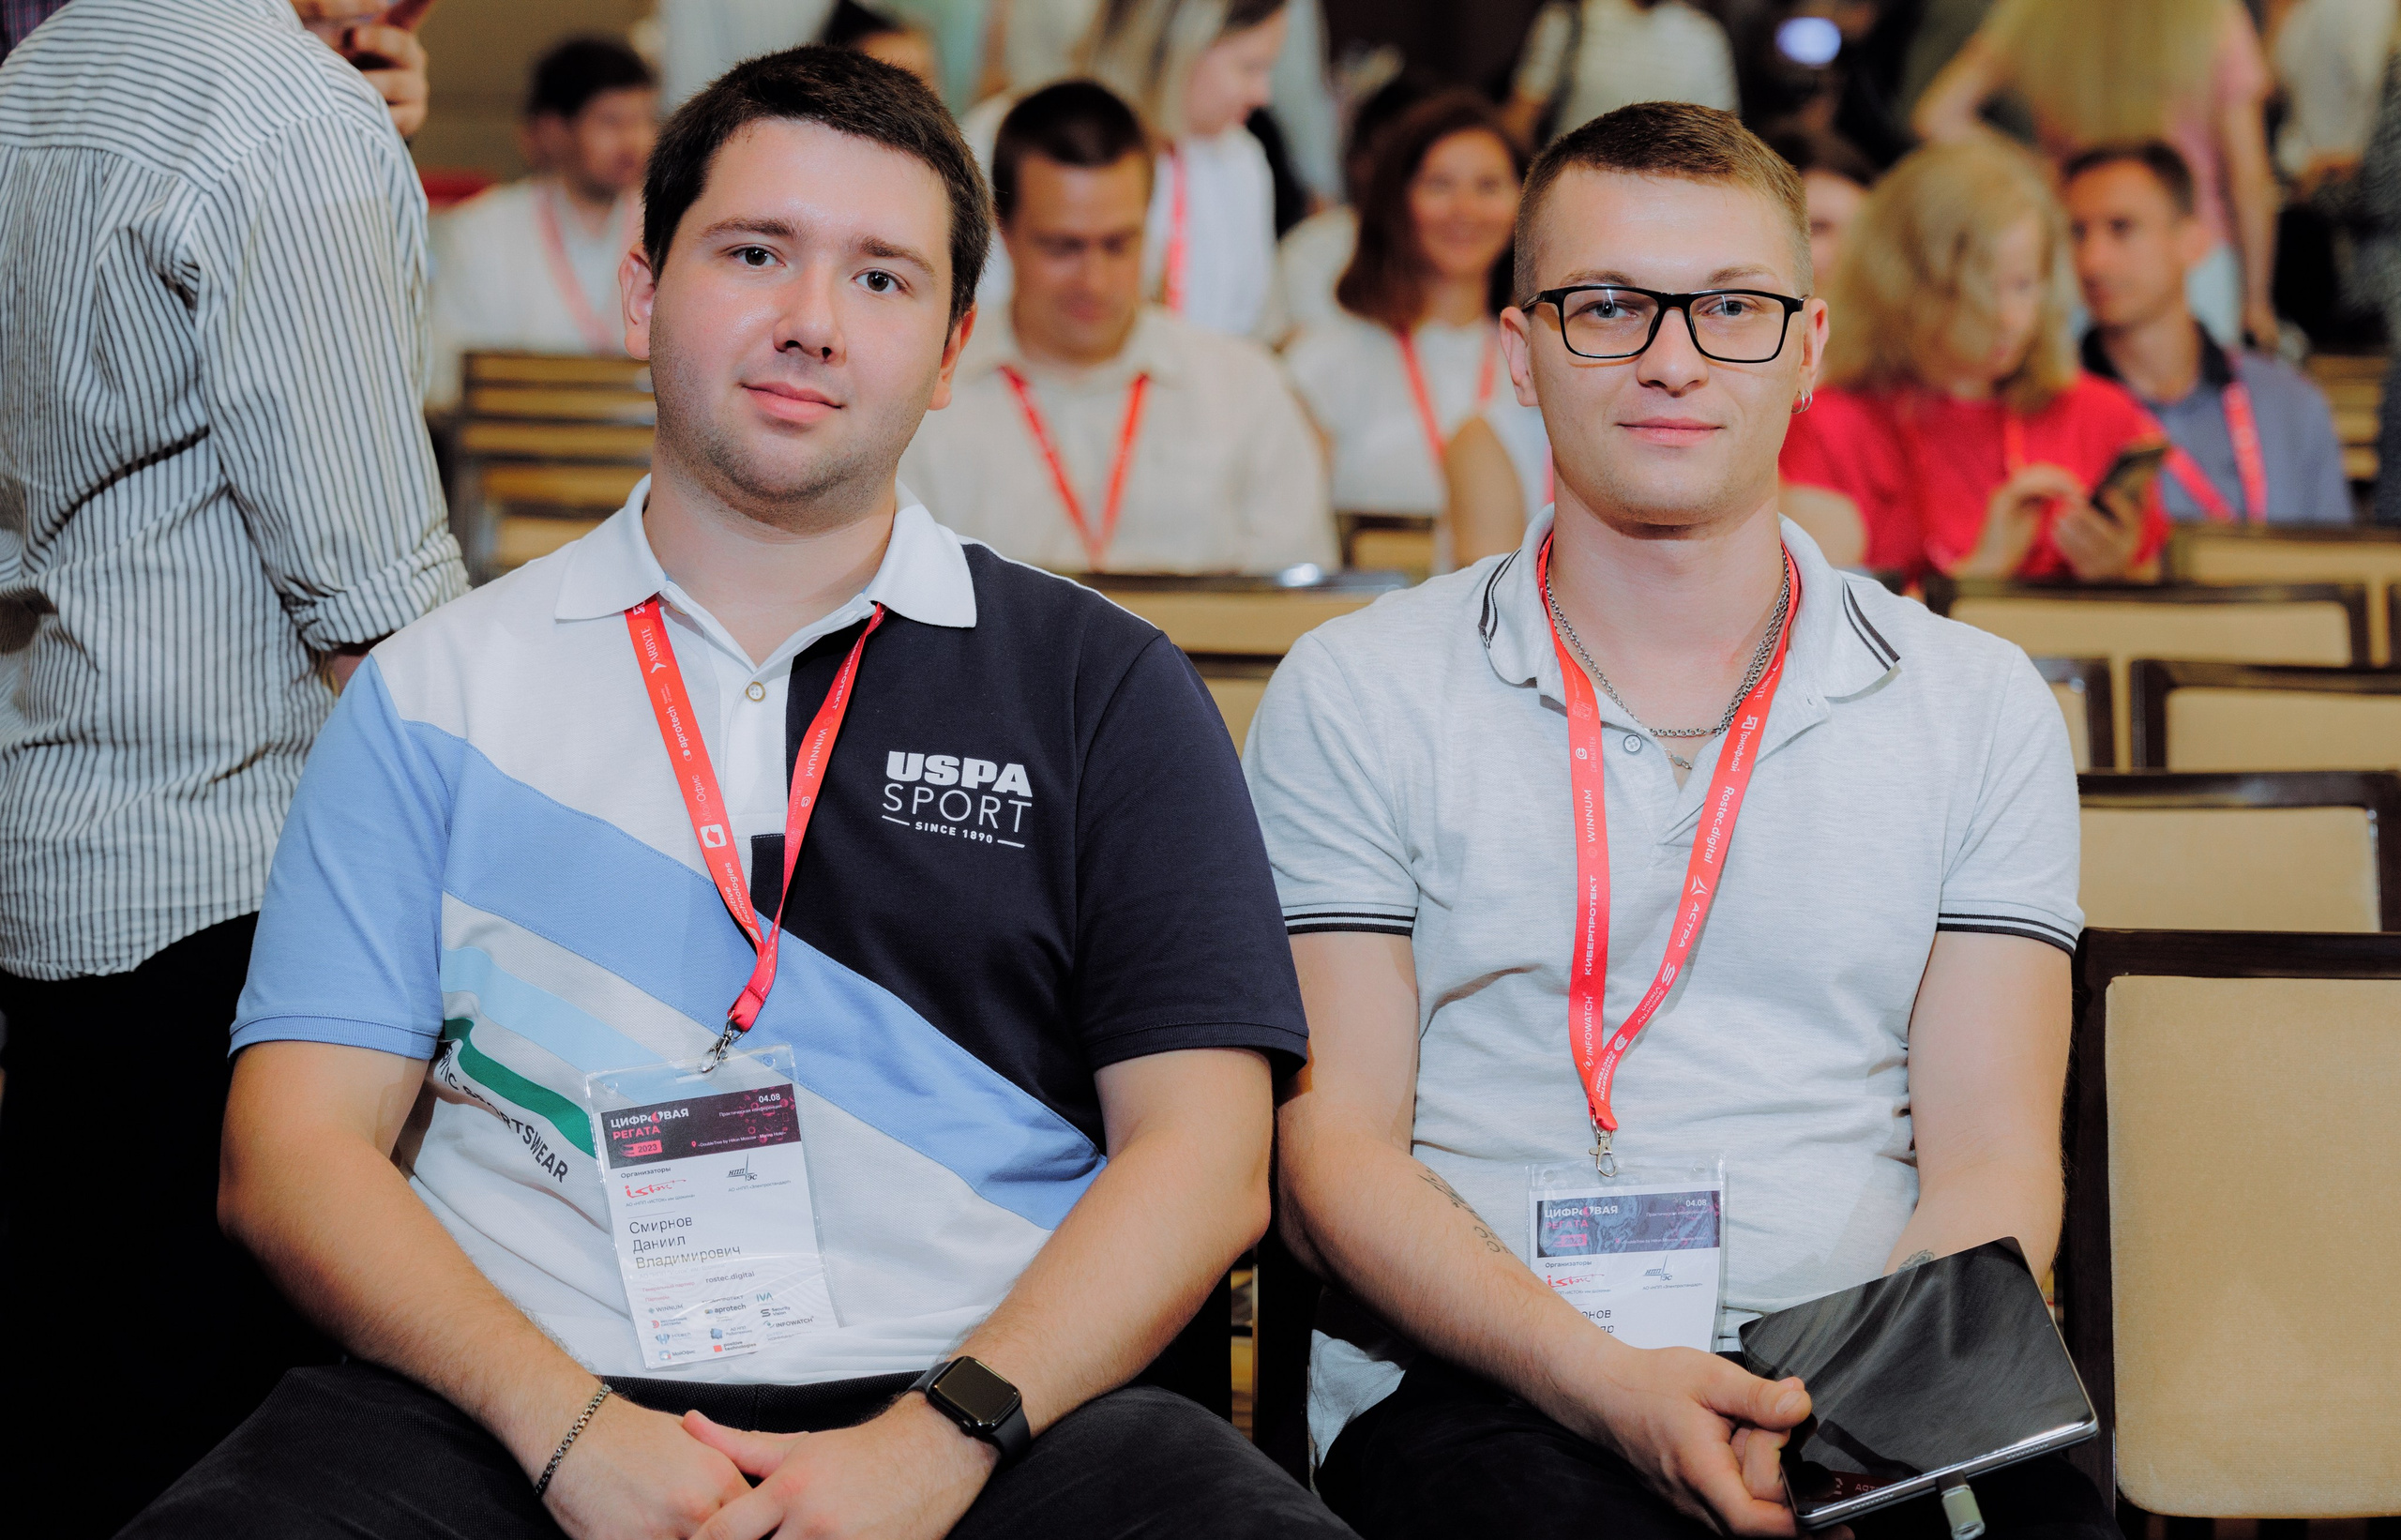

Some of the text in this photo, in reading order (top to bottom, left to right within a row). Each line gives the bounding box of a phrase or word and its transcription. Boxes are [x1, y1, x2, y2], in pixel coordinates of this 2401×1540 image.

[666, 705, 688, 748] aprotech
[806, 728, 828, 778] WINNUM
[886, 751, 1033, 797] USPA
[883, 783, 1032, 832] SPORT
[1584, 790, 1595, 842] WINNUM
[915, 822, 993, 844] SINCE 1890
[1703, 785, 1735, 864] Rostec.digital
[725, 862, 752, 924] technologies
[725, 886, 747, 923] positive
[1585, 875, 1596, 975] КИБЕРПРОТЕКТ
[1678, 901, 1699, 947] АСТРА
[1638, 989, 1665, 1025] Security
[1641, 987, 1661, 1012] Vision
[1584, 996, 1593, 1056] INFOWATCH
[1596, 1050, 1613, 1093] СИСТЕМЫ
[758, 1093, 780, 1103] 04.08
[718, 1103, 782, 1117] Практическая конференция
[612, 1125, 660, 1140] РЕГАТА
[637, 1143, 657, 1153] 2023
[621, 1167, 671, 1179] Организаторы
[629, 1215, 692, 1235] Смирнов
[1545, 1218, 1588, 1229] РЕГАТА
[632, 1235, 686, 1254] Даниил
[1564, 1236, 1582, 1245] 2023
[635, 1246, 740, 1269] Владимирович
[1545, 1260, 1592, 1268] Организаторы
[705, 1271, 754, 1284] rostec.digital
[756, 1291, 773, 1302] IVA
[656, 1304, 683, 1312] WINNUM
[715, 1303, 746, 1314] aprotech
[672, 1349, 695, 1357] МойОфис
[724, 1341, 756, 1351] technologies
